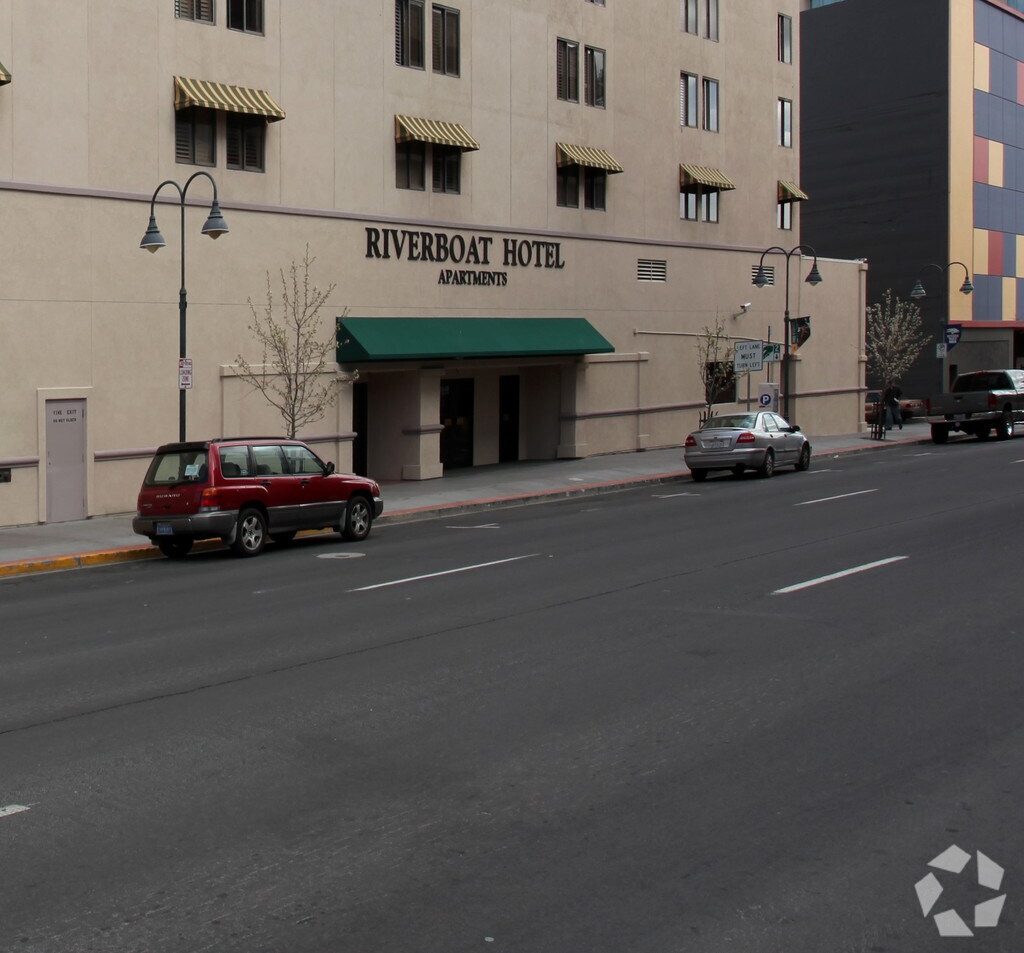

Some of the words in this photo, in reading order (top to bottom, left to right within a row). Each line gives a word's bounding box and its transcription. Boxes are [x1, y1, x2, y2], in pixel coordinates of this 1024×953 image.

[365, 227, 493, 264] RIVERBOAT
[502, 238, 566, 269] HOTEL
[438, 269, 508, 286] APARTMENTS
[762, 396, 770, 404] P
